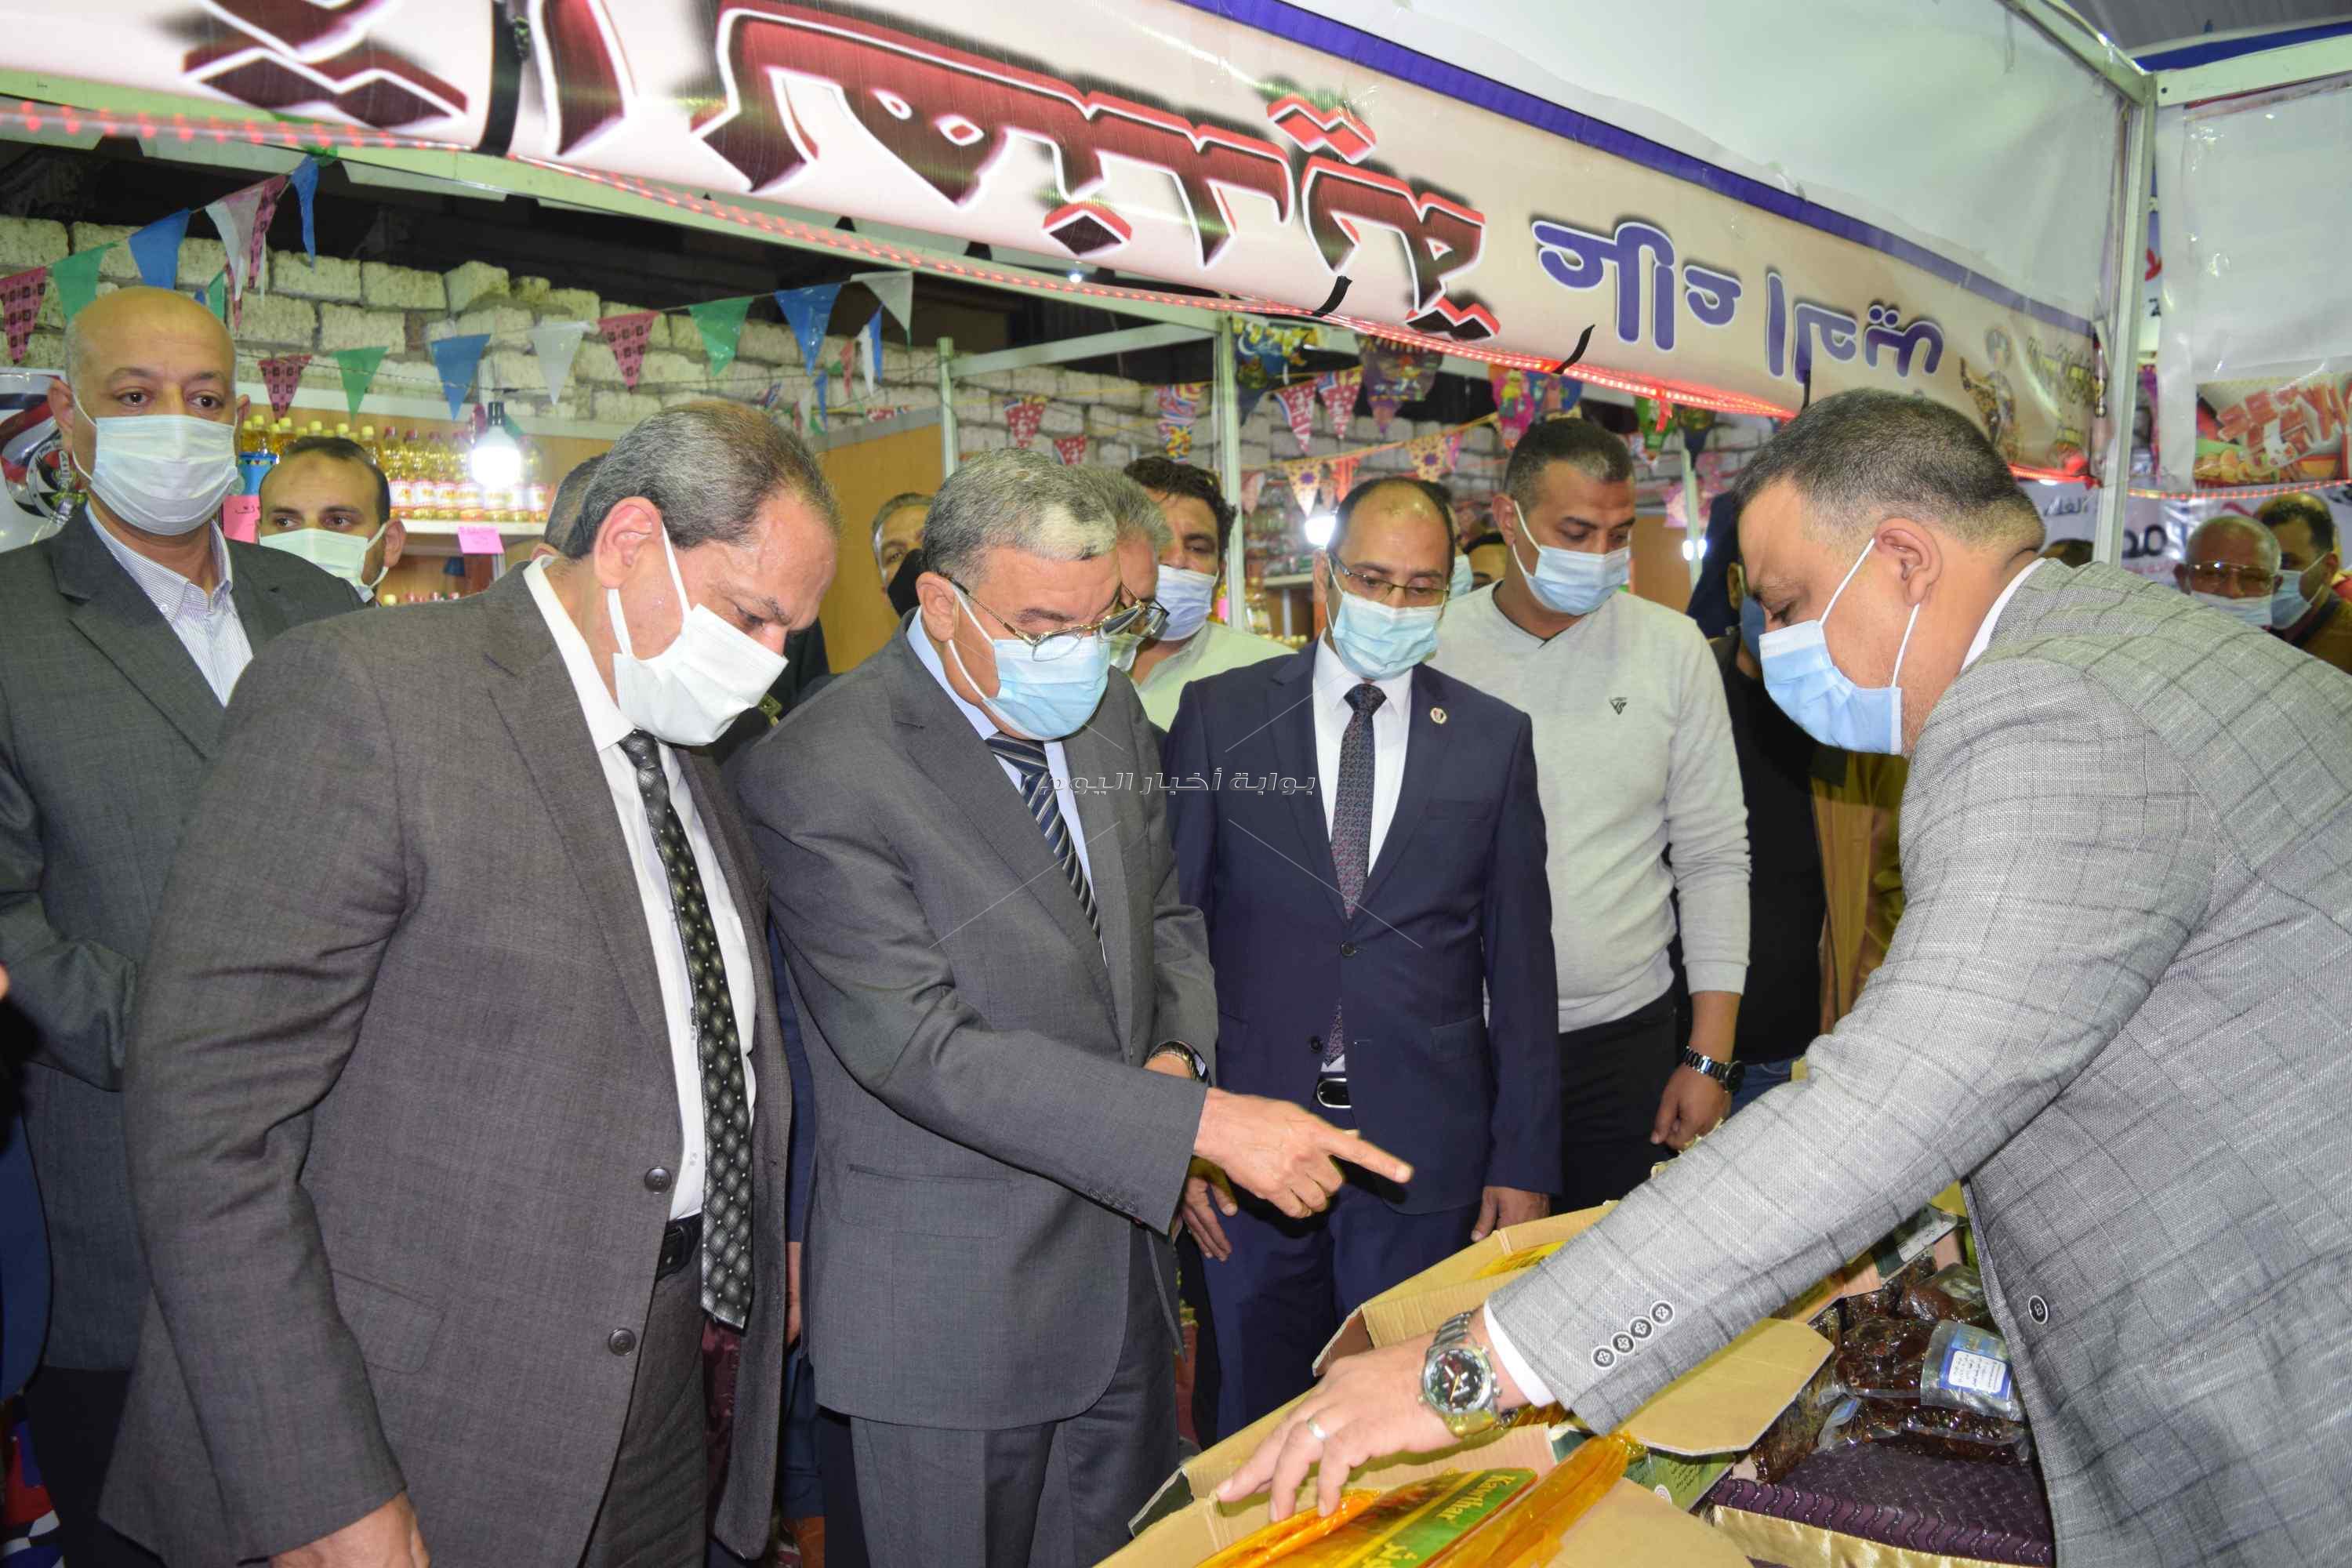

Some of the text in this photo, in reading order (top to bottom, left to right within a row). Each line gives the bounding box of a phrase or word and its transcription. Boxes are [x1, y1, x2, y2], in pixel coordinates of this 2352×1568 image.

[1531, 220, 1742, 352] علاء
[1766, 272, 1944, 384] الدين
[1437, 1475, 1516, 1521] Kawthar
